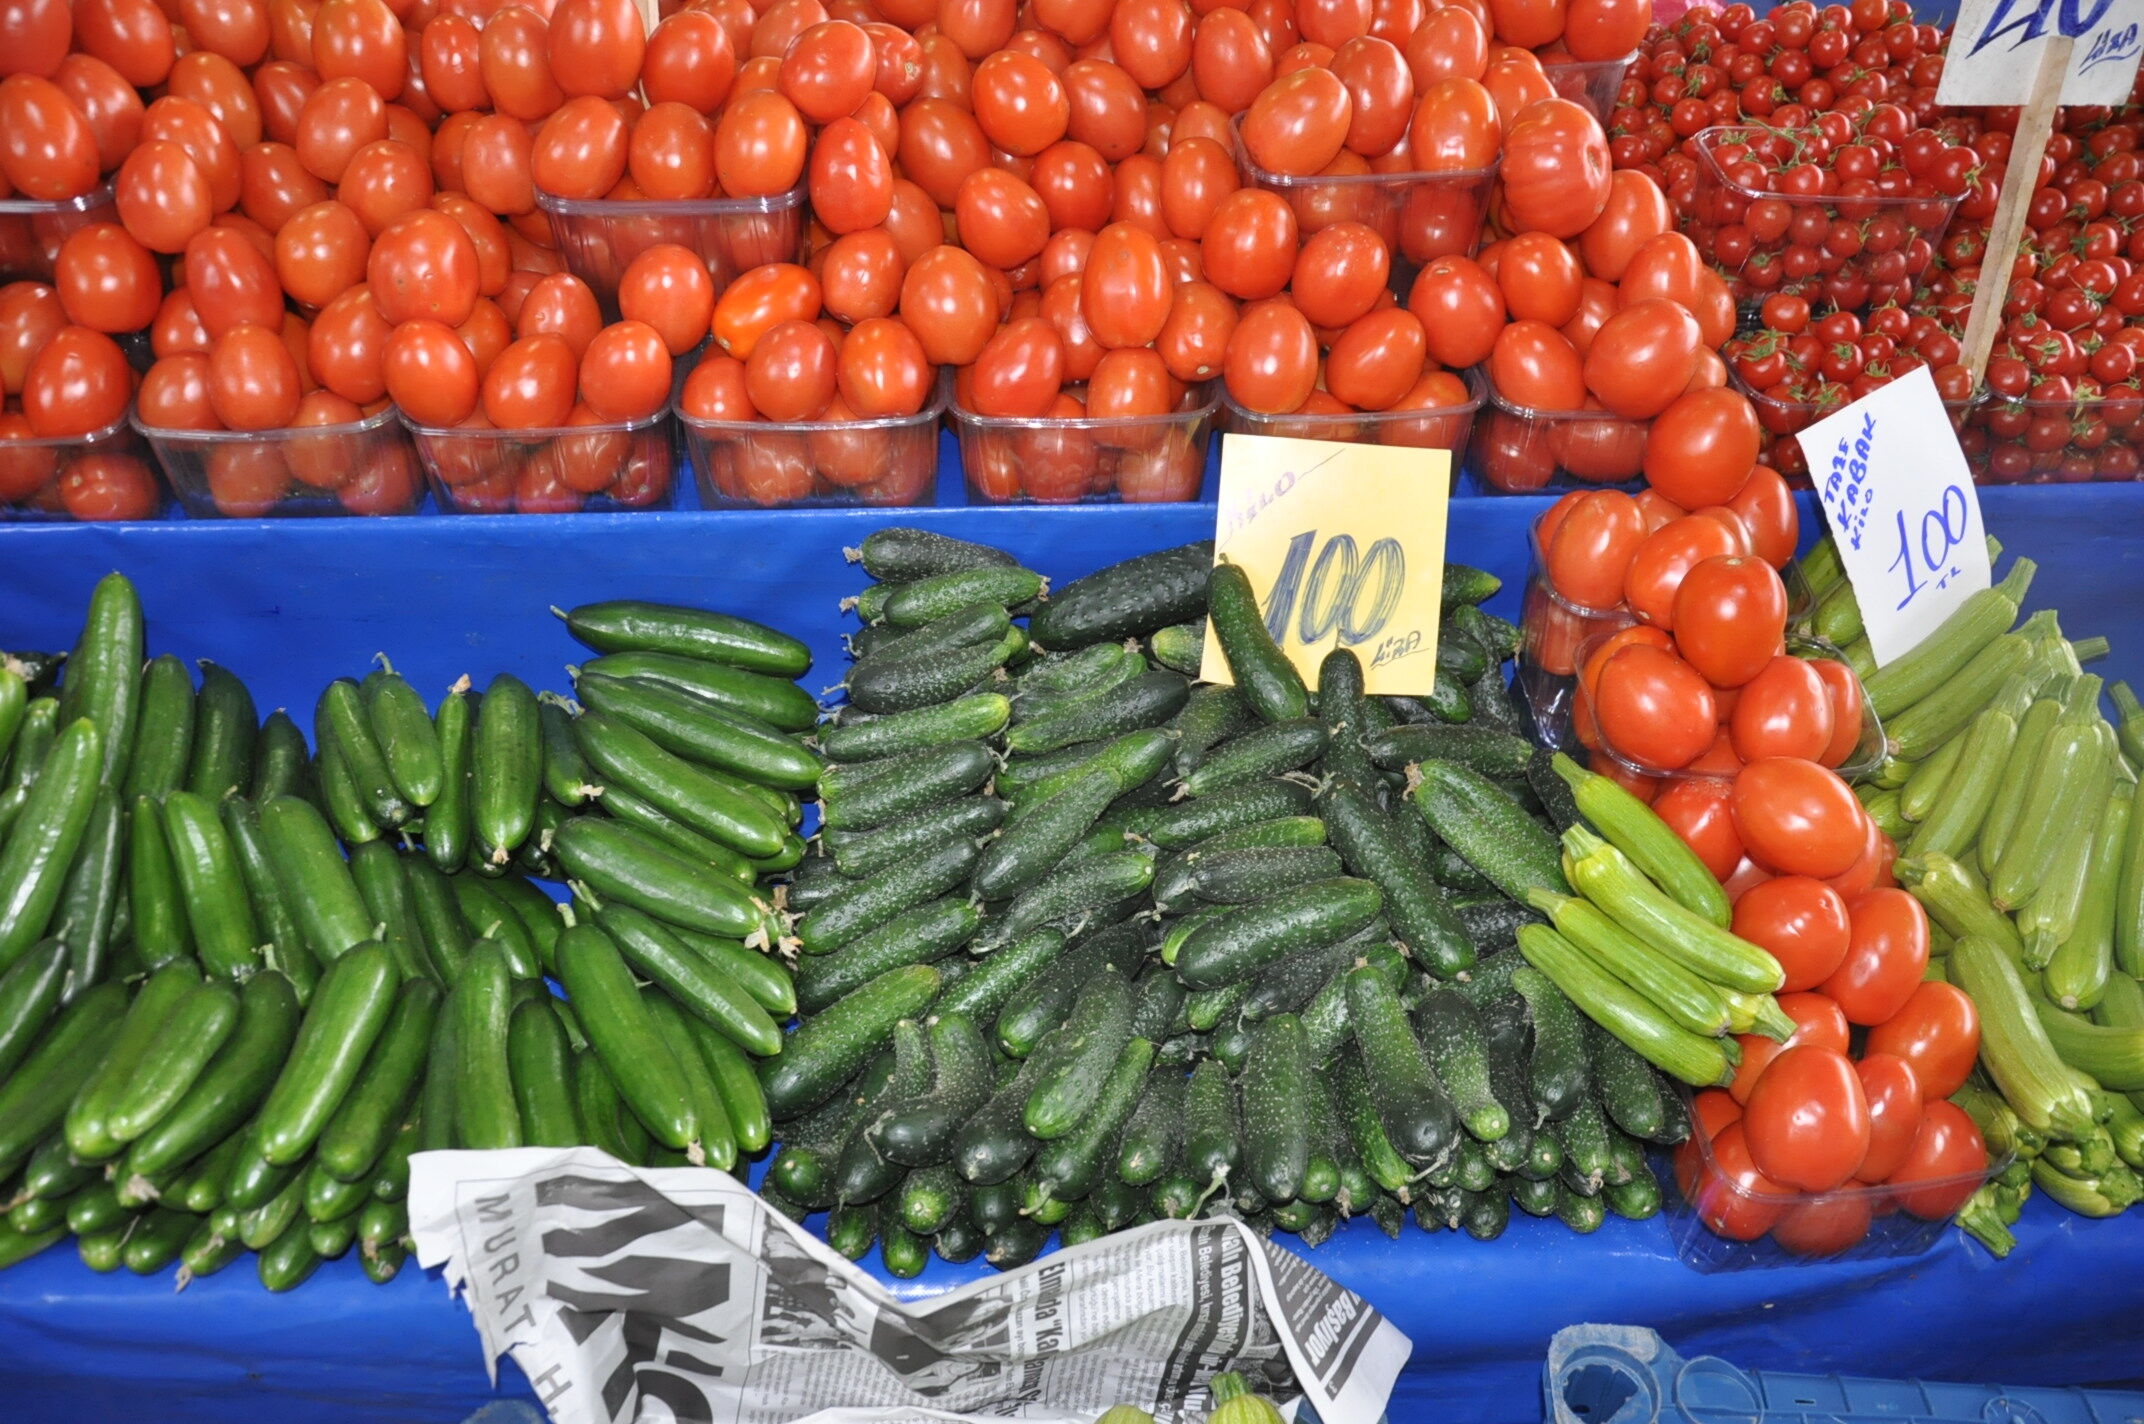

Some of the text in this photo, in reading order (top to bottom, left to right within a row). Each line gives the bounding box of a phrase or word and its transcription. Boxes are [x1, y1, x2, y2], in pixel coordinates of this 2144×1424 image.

[1836, 411, 1876, 533] KABAK
[1261, 529, 1405, 647] 100
[1887, 484, 1967, 611] 100
[1936, 566, 1961, 590] TL
[475, 1193, 537, 1334] MURAT
